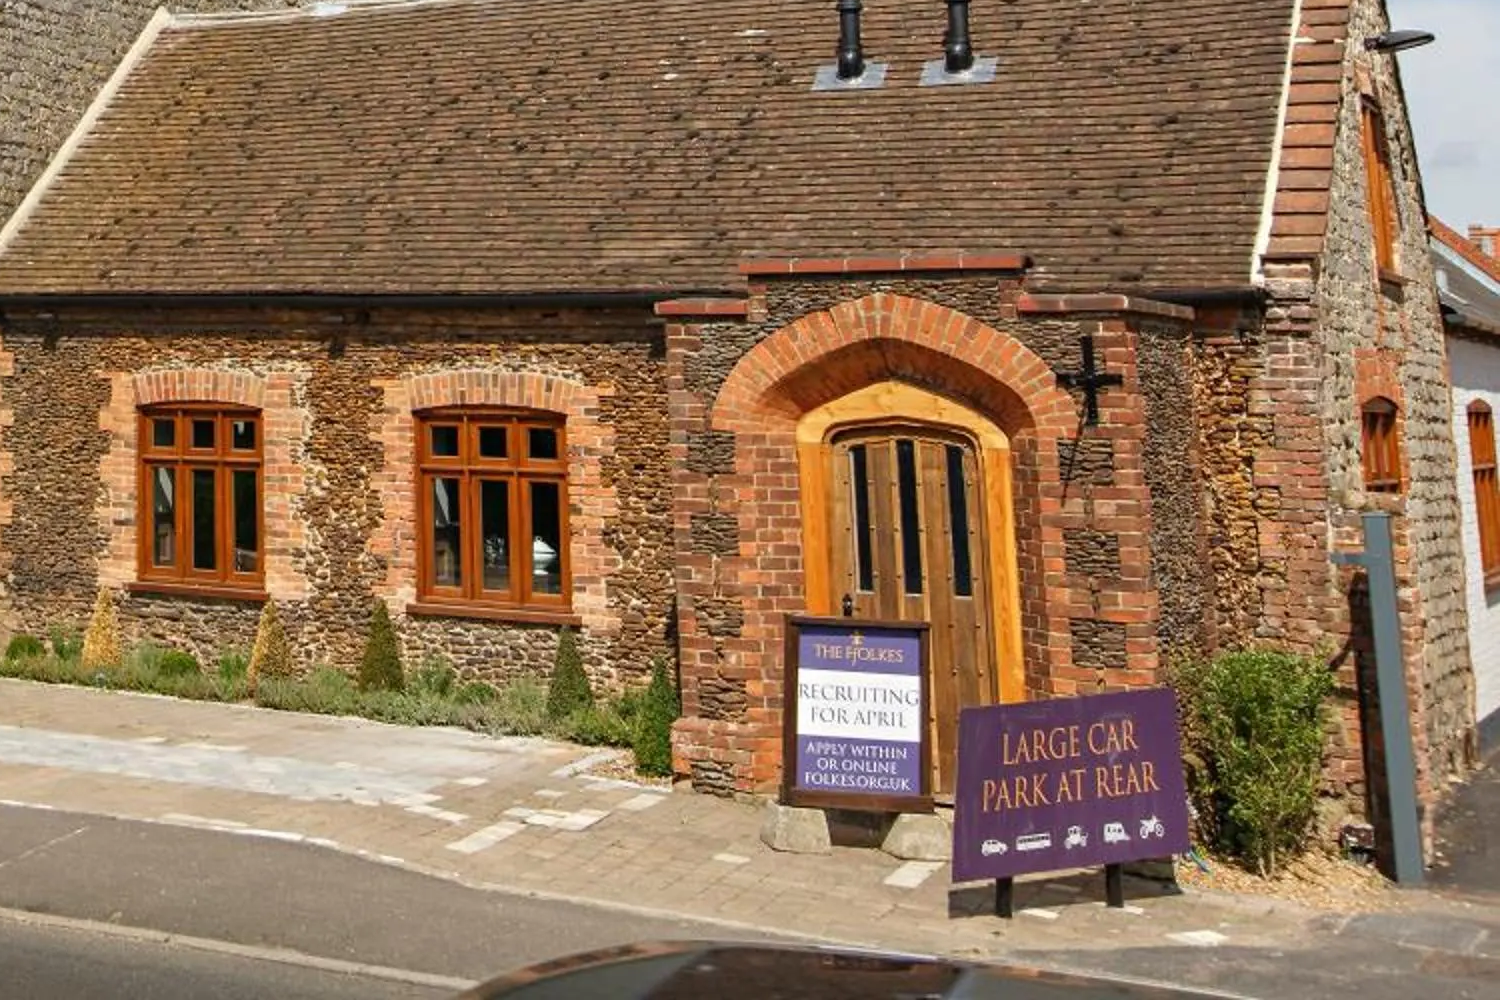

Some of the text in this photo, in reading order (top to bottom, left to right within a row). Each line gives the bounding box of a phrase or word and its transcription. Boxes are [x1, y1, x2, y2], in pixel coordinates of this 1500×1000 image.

[812, 643, 842, 659] THE
[799, 683, 919, 706] RECRUITING
[811, 706, 907, 729] FOR APRIL
[805, 741, 908, 759] APPLY WITHIN
[1002, 719, 1140, 766] LARGE CAR
[817, 757, 897, 775] OR ONLINE
[981, 761, 1161, 812] PARK AT REAR
